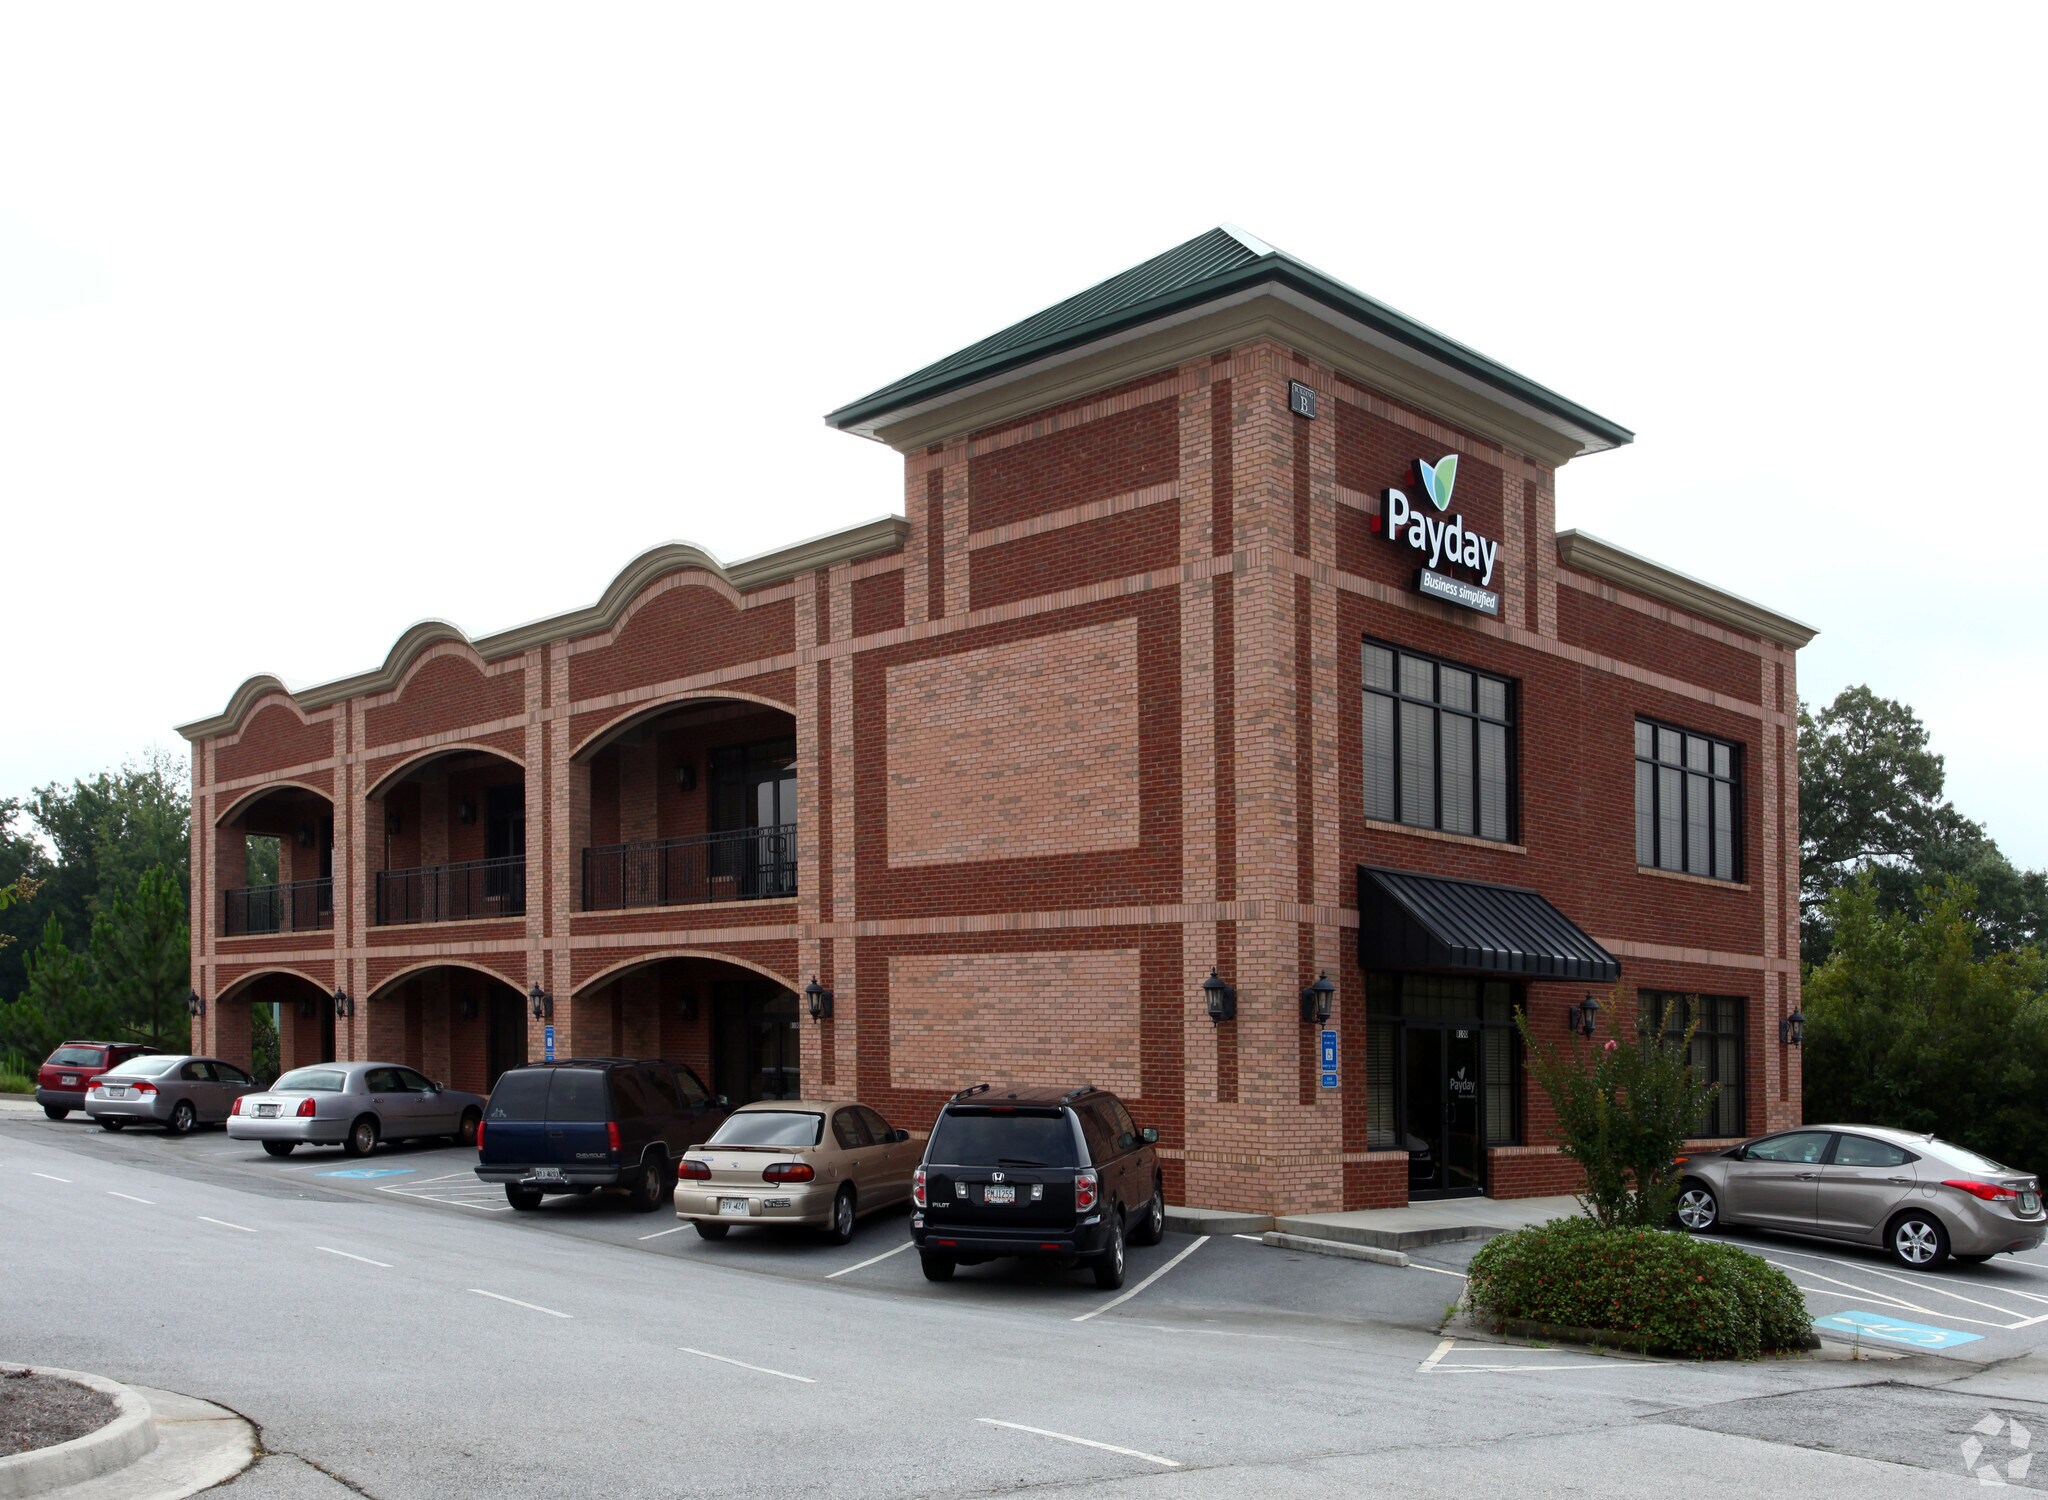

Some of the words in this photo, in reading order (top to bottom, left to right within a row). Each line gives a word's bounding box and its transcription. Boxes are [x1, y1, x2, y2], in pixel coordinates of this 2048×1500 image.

[1301, 396, 1308, 412] B
[1389, 488, 1498, 586] Payday
[1424, 572, 1458, 596] Business
[1459, 585, 1496, 608] simplified
[1450, 1078, 1475, 1093] Payday
